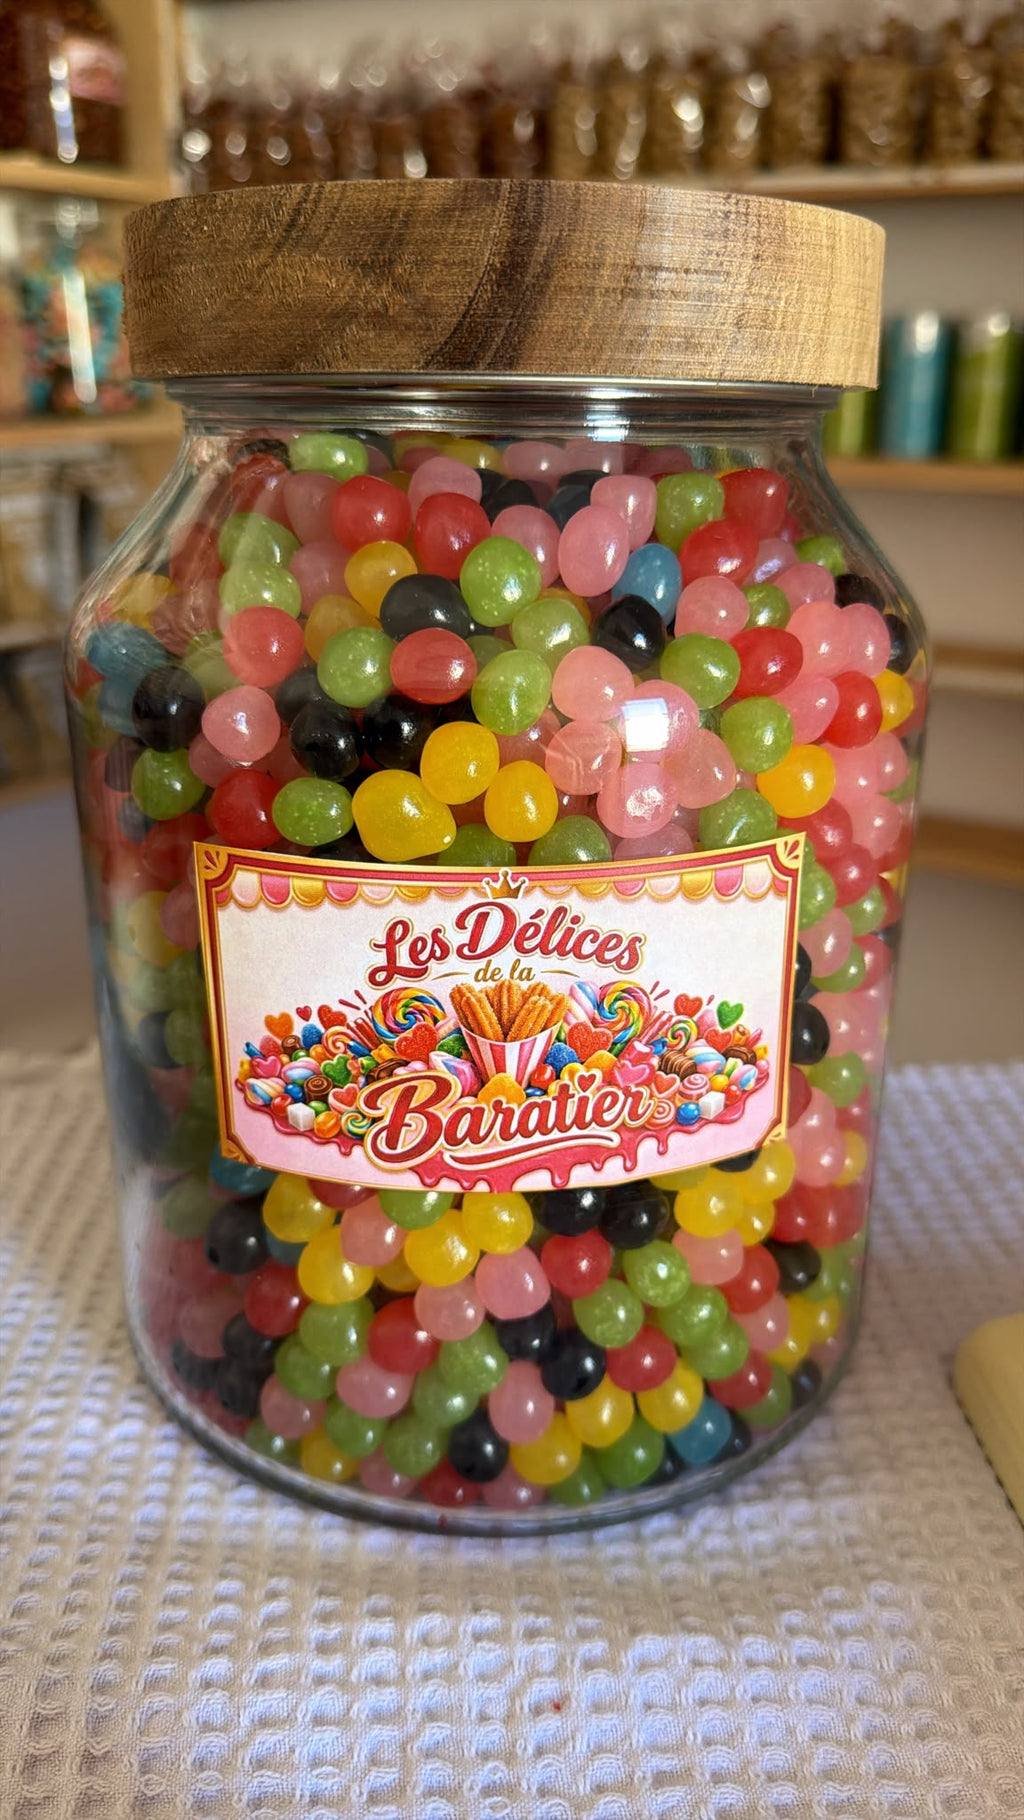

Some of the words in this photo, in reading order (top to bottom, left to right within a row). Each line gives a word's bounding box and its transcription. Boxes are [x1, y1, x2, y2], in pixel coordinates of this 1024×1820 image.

[368, 919, 450, 987] Les
[455, 901, 644, 970] Délices
[474, 959, 503, 983] de
[510, 958, 536, 982] la
[363, 1074, 653, 1163] Baratier
